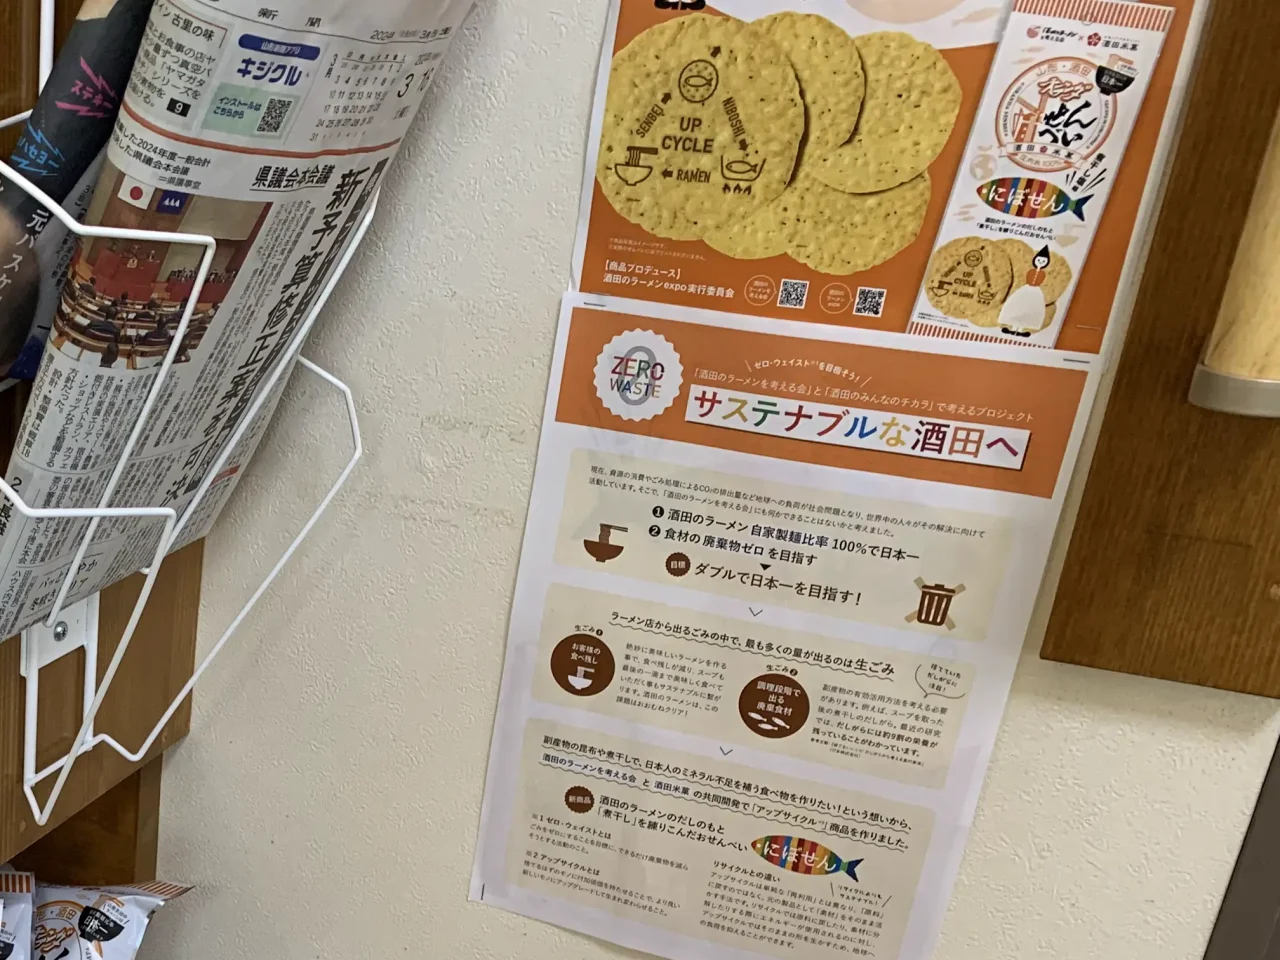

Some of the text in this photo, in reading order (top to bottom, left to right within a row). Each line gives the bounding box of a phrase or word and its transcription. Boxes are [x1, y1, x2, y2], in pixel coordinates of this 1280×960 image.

[236, 57, 303, 87] キジクル
[1035, 62, 1093, 77] 山形・酒田
[213, 105, 245, 119] こちらから
[218, 96, 262, 112] インストールは
[1043, 100, 1098, 130] せん
[635, 103, 664, 139] SENBEI
[679, 116, 703, 133] UP
[721, 96, 747, 139] NIBOSHI
[661, 135, 715, 154] CYCLE
[1038, 128, 1084, 148] べい
[252, 163, 336, 190] 県議会本会議
[676, 168, 711, 183] RAMEN
[987, 184, 1064, 213] にぼせん
[984, 216, 1054, 234] 酒田のラーメンのだしのもと
[604, 258, 682, 281] 【商品プロデュース】
[610, 355, 665, 381] ZERO
[609, 377, 662, 399] WASTE
[693, 389, 1019, 459] サステナブルな酒田へ
[663, 527, 818, 566] 食材の 廃棄物ゼロ を目指す
[667, 507, 920, 562] 酒田のラーメン 自家製麺比率 100%で日本一
[669, 560, 686, 570] 目標
[570, 651, 598, 665] 食べ残し
[571, 642, 601, 655] お客様の
[625, 642, 728, 670] 絶妙に美味しいラーメンを作る
[622, 664, 724, 692] 最後の一滴まで美味しく食べて
[756, 680, 802, 698] 調理段階で
[767, 694, 785, 704] 出る
[821, 683, 949, 716] 副産物の有効活用方法を考える必要
[542, 752, 637, 783] 酒田のラーメンを考える会
[653, 780, 691, 796] 酒田米菓
[599, 794, 725, 836] 酒田のラーメンのだしのもと
[597, 807, 748, 852] 「煮干し」を練りこんだおせんべい
[763, 840, 837, 872] にぼせん
[713, 860, 781, 883] リサイクルとの違い
